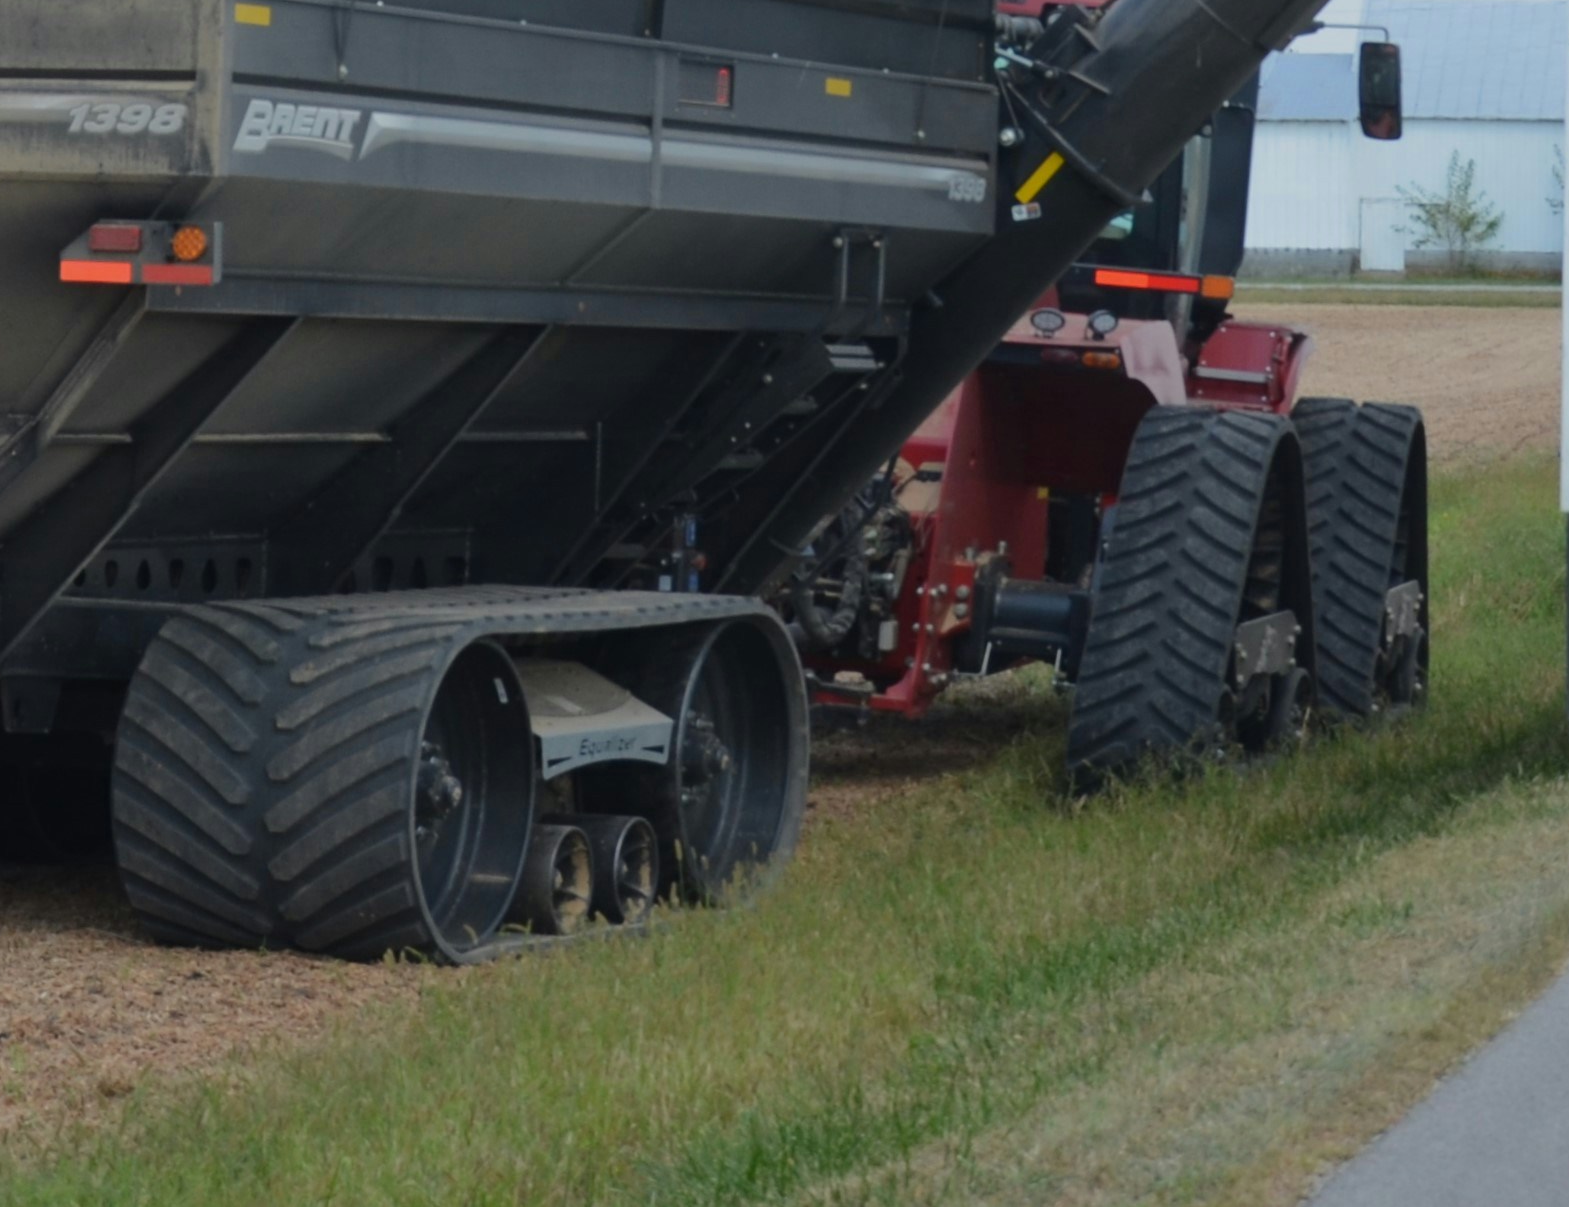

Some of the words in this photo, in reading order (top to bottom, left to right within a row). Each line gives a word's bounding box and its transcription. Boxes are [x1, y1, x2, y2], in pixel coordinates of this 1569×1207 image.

[67, 103, 188, 135] 1398
[233, 99, 361, 155] BRENT
[948, 177, 987, 203] 1398
